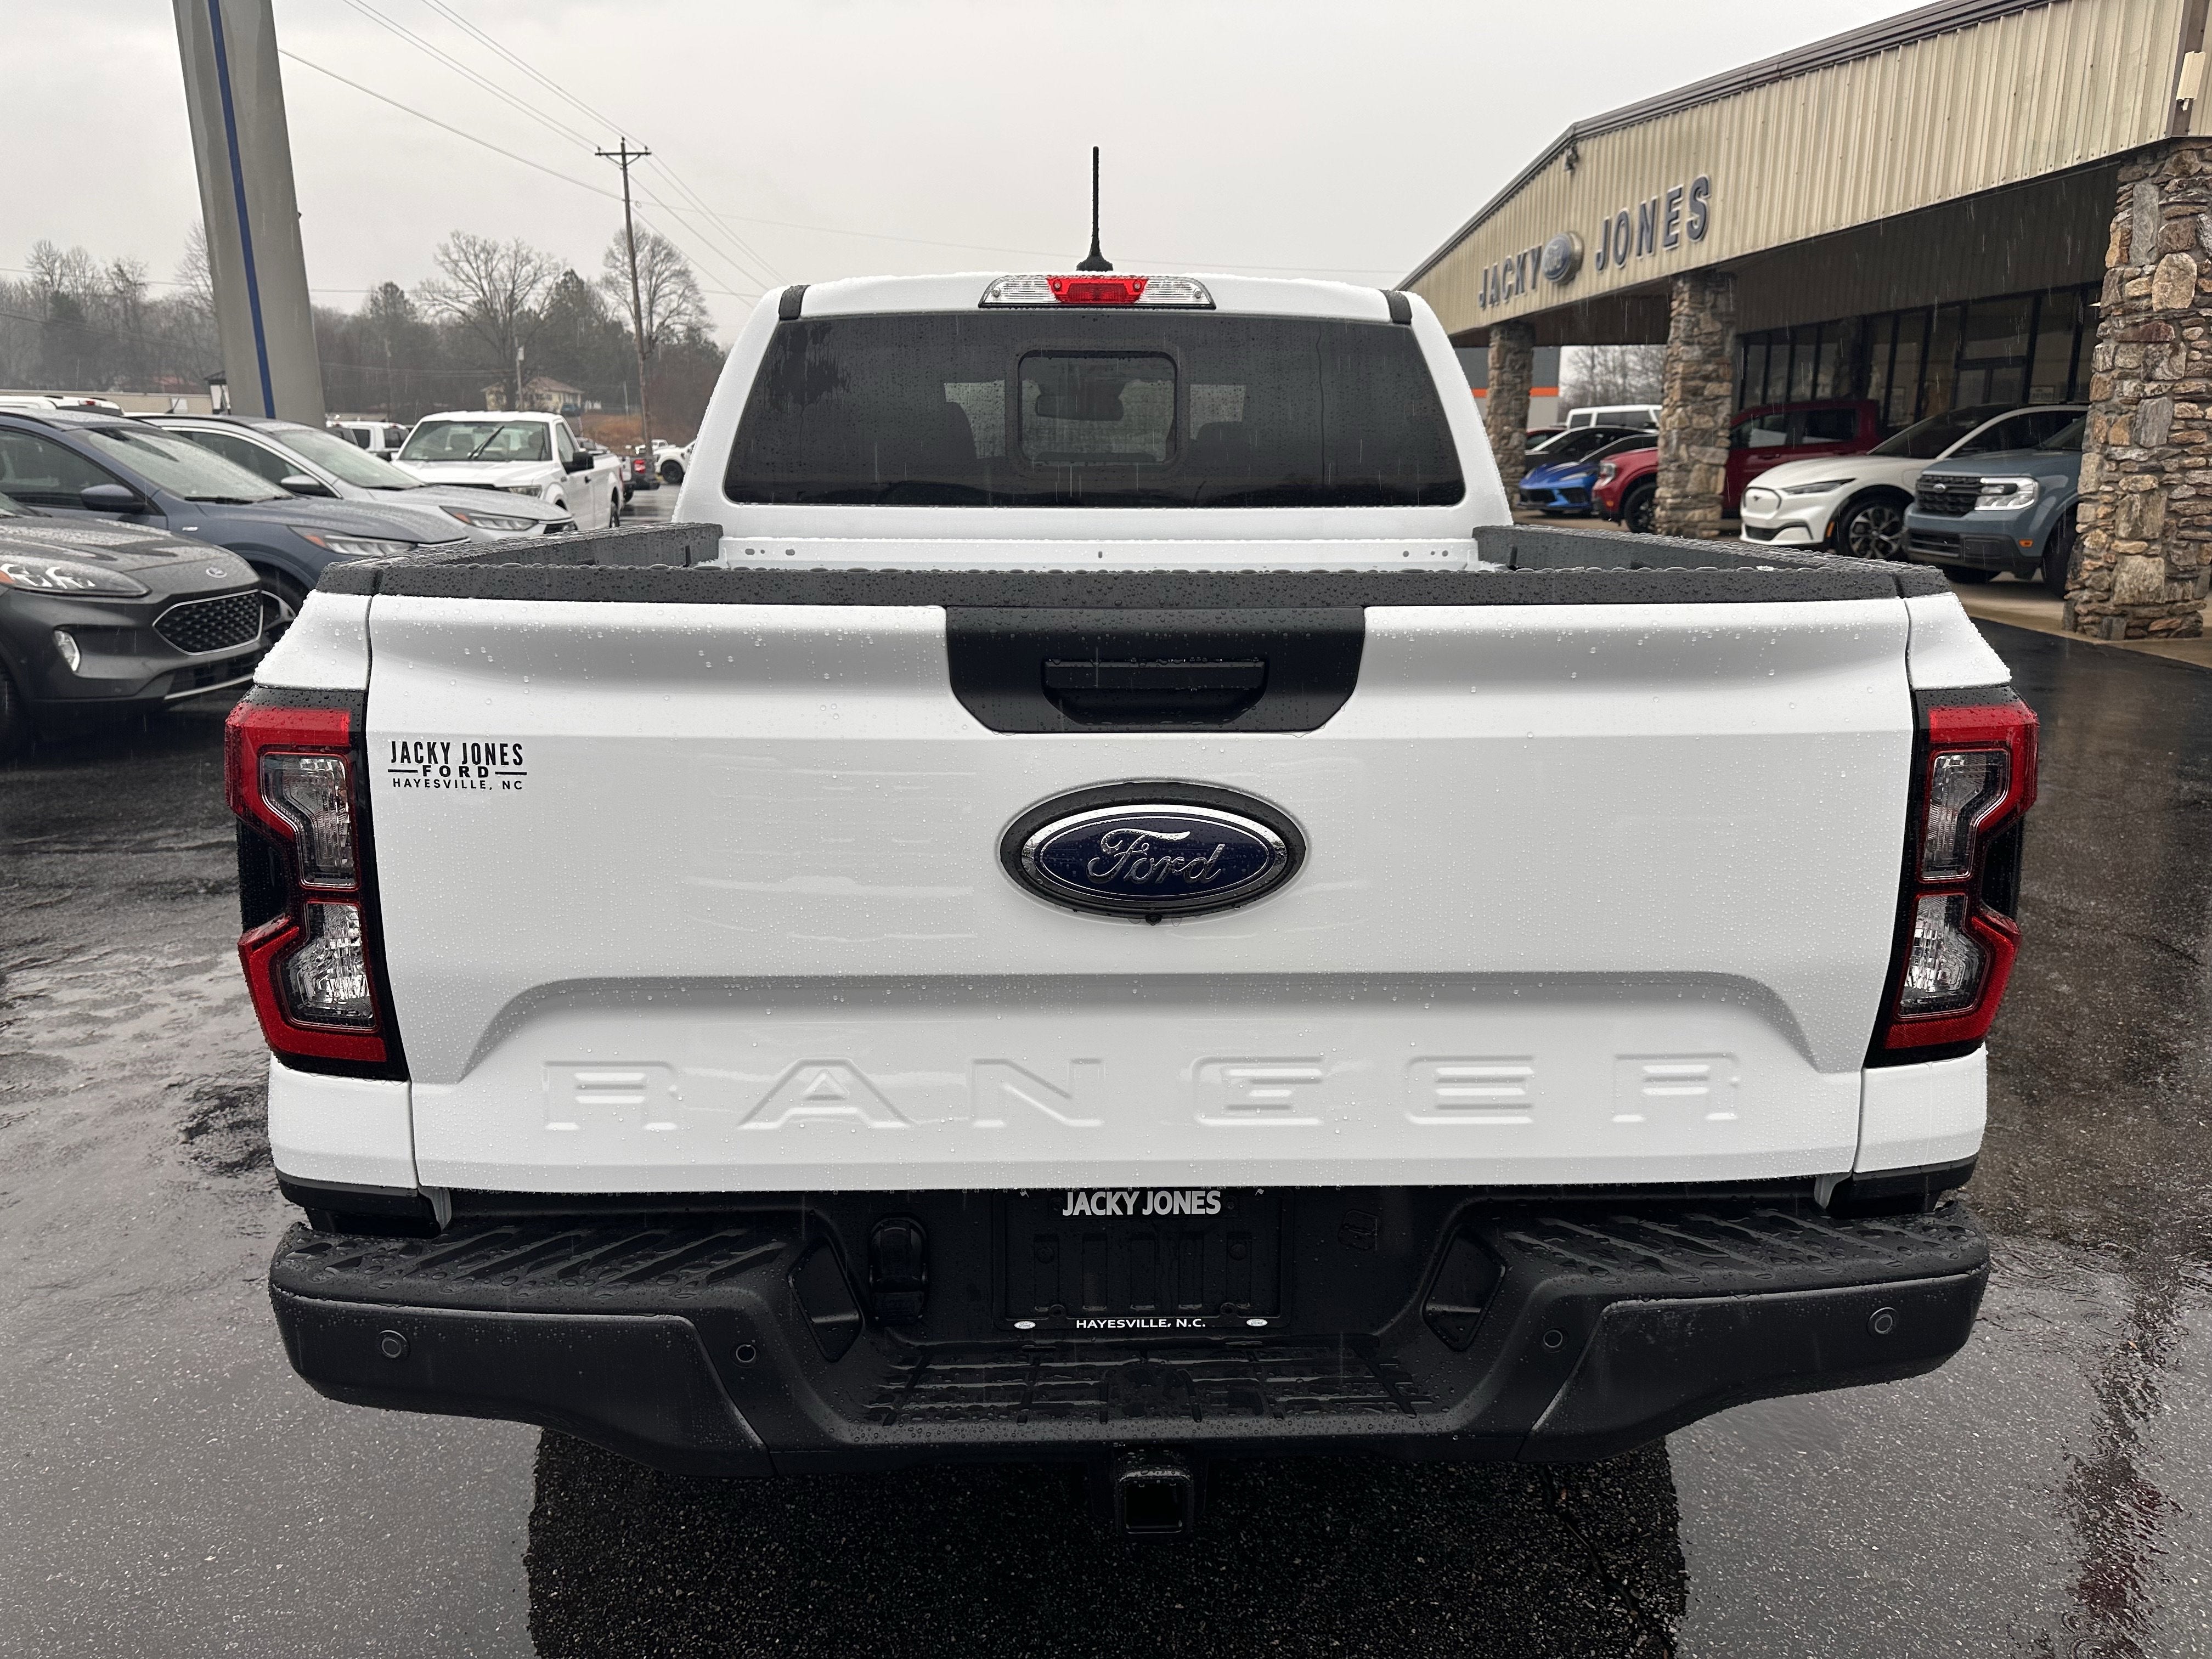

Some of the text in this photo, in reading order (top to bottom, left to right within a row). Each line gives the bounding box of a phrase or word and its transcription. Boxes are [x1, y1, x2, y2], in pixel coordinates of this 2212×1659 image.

[1479, 245, 1542, 309] JACKY
[1595, 173, 1710, 273] JONES
[391, 741, 523, 766] JACKY JONES
[422, 764, 489, 778] FORD
[392, 778, 523, 791] HAYESVILLE, NC
[1086, 827, 1226, 884] Ford
[543, 1052, 1739, 1130] RANGER
[1062, 1190, 1222, 1216] JACKY JONES
[1076, 1318, 1206, 1329] HAYESVILLE, N.C.
